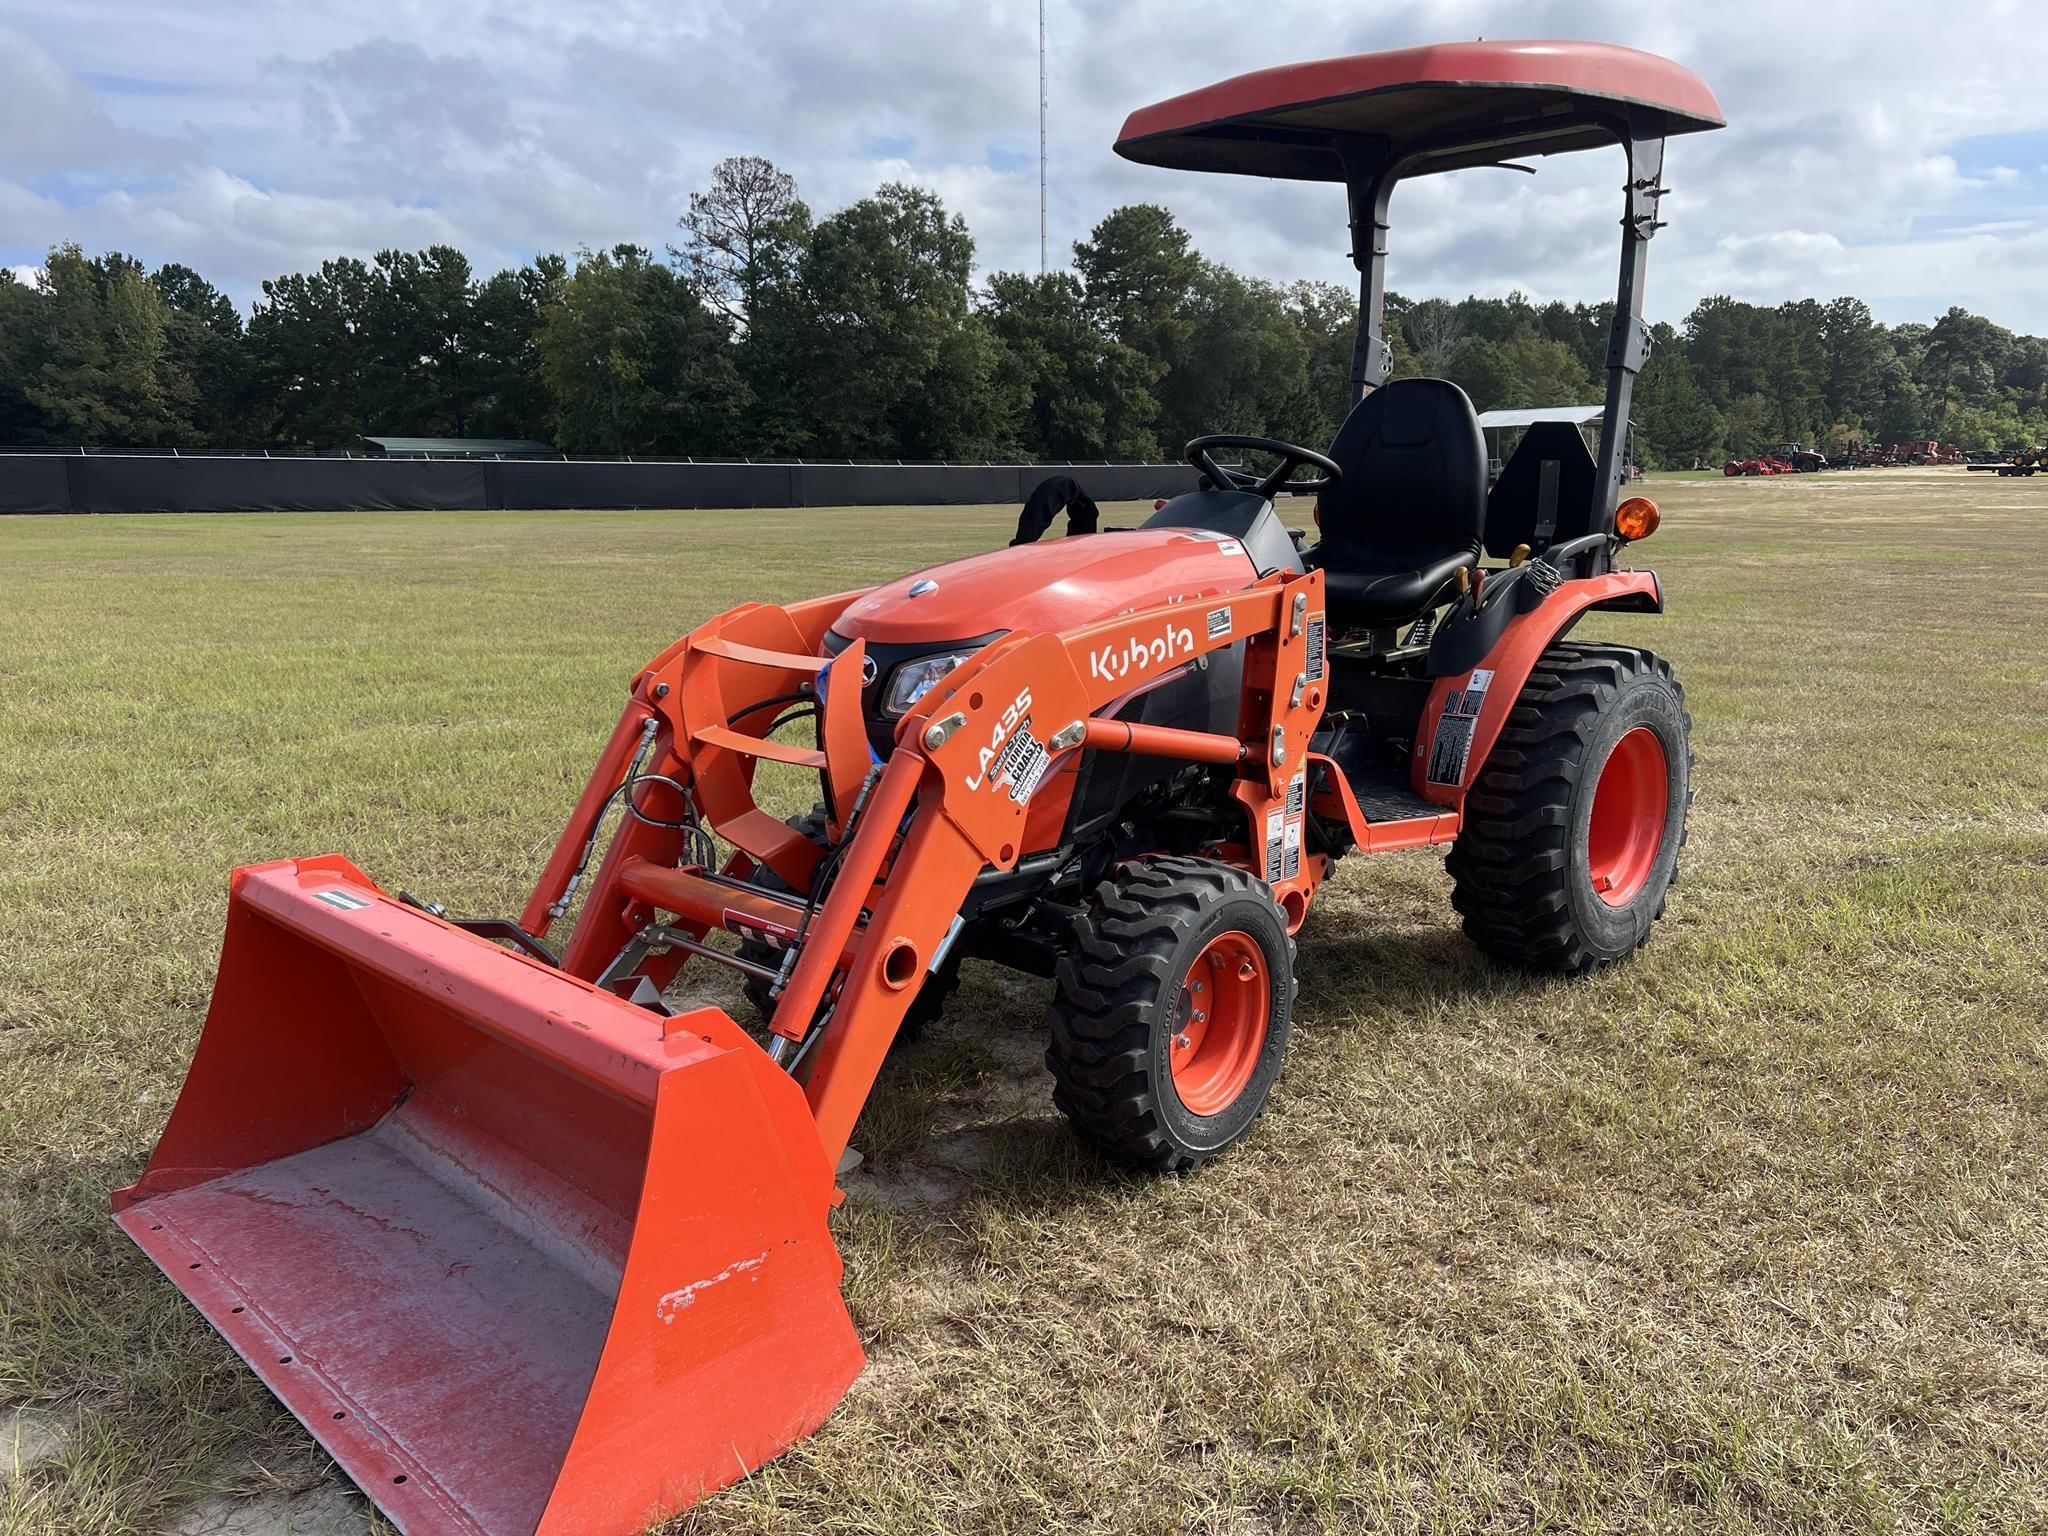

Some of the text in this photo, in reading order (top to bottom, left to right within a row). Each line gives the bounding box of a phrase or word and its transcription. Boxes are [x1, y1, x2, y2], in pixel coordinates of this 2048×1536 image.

[1090, 623, 1194, 682] Kubota
[965, 686, 1032, 791] LA435
[1003, 731, 1032, 773] FLORIDA
[1011, 740, 1039, 781] COAST
[1010, 746, 1043, 797] EQUIPMENT
